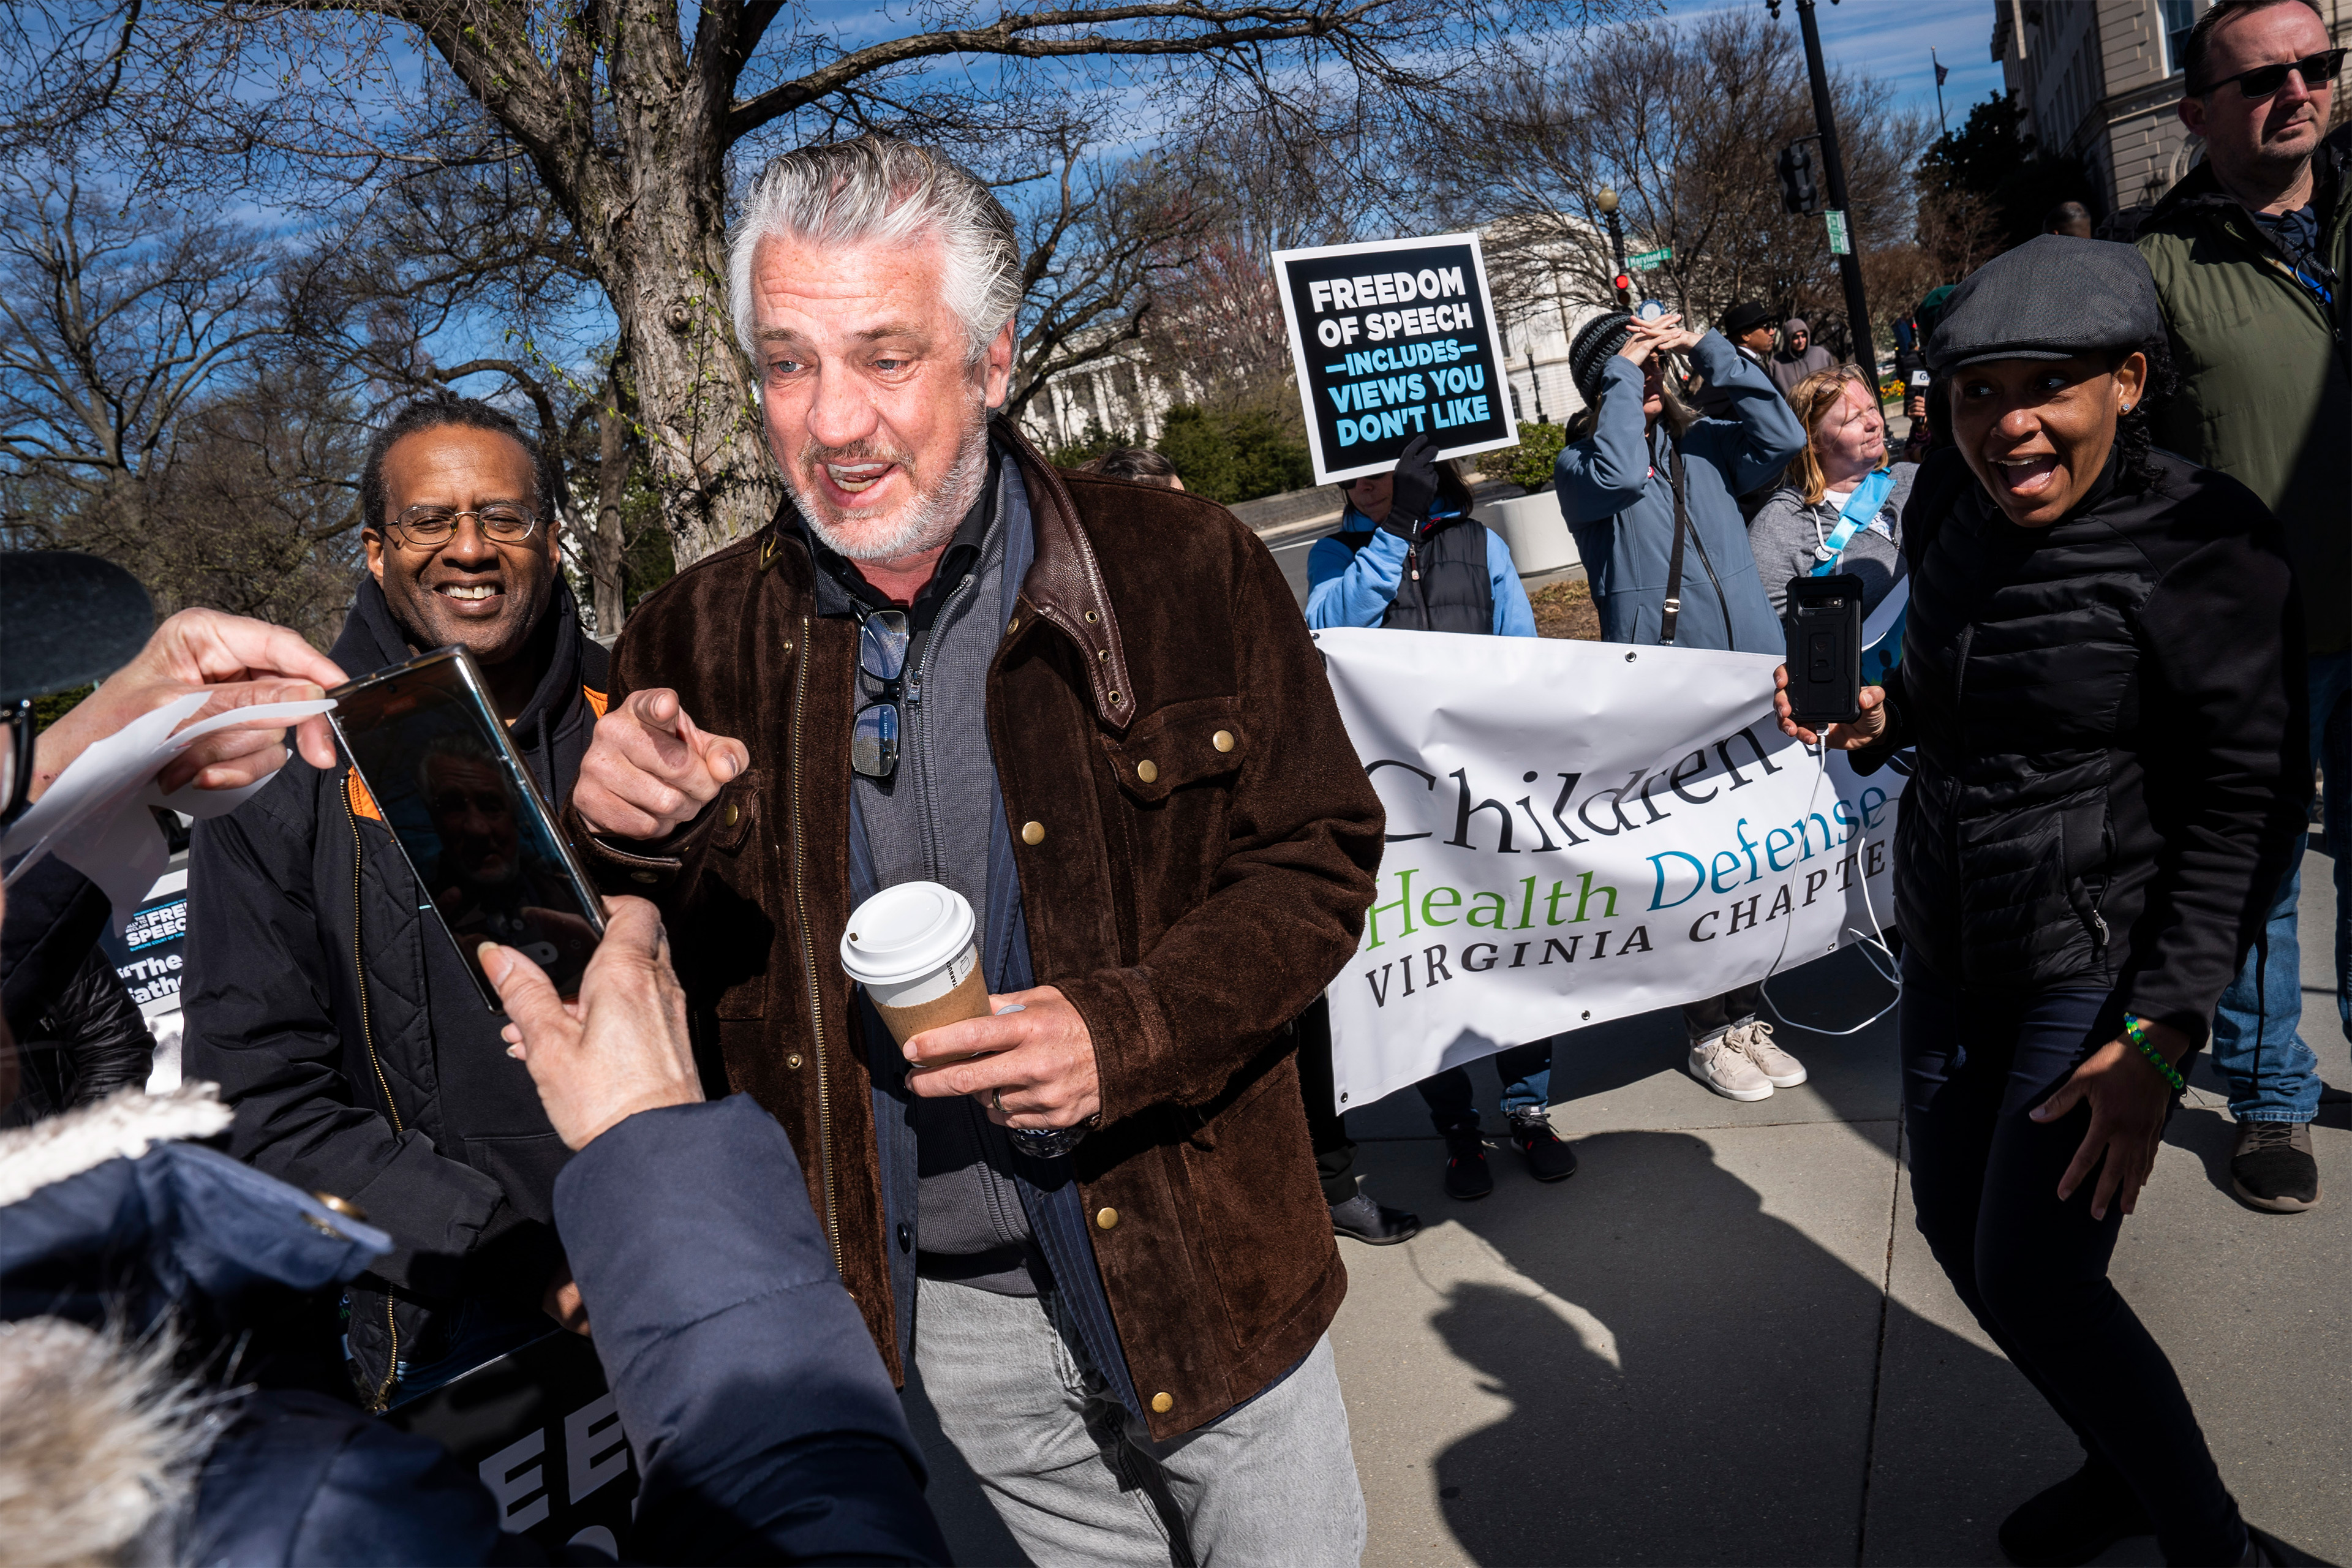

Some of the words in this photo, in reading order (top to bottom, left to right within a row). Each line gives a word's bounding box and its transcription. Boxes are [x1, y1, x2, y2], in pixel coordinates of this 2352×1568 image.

[1630, 251, 1661, 266] Maryland
[1643, 262, 1657, 270] 100
[1308, 266, 1466, 313] FREEDOM
[1317, 315, 1360, 348] OF
[1364, 302, 1474, 341] SPEECH
[1327, 374, 1427, 413] VIEWS
[1428, 364, 1485, 397] YOU
[1336, 405, 1427, 447] DON'T
[1432, 394, 1491, 429] LIKE
[1363, 715, 1831, 853] Children
[1365, 868, 1619, 952] Health
[1645, 786, 1888, 912] Defense
[126, 918, 186, 946] SPEEC
[130, 942, 152, 952] SUPREME
[151, 937, 167, 946] COURT
[1365, 925, 1654, 1009] VIRGINIA
[1688, 839, 1894, 943] CHAPTE
